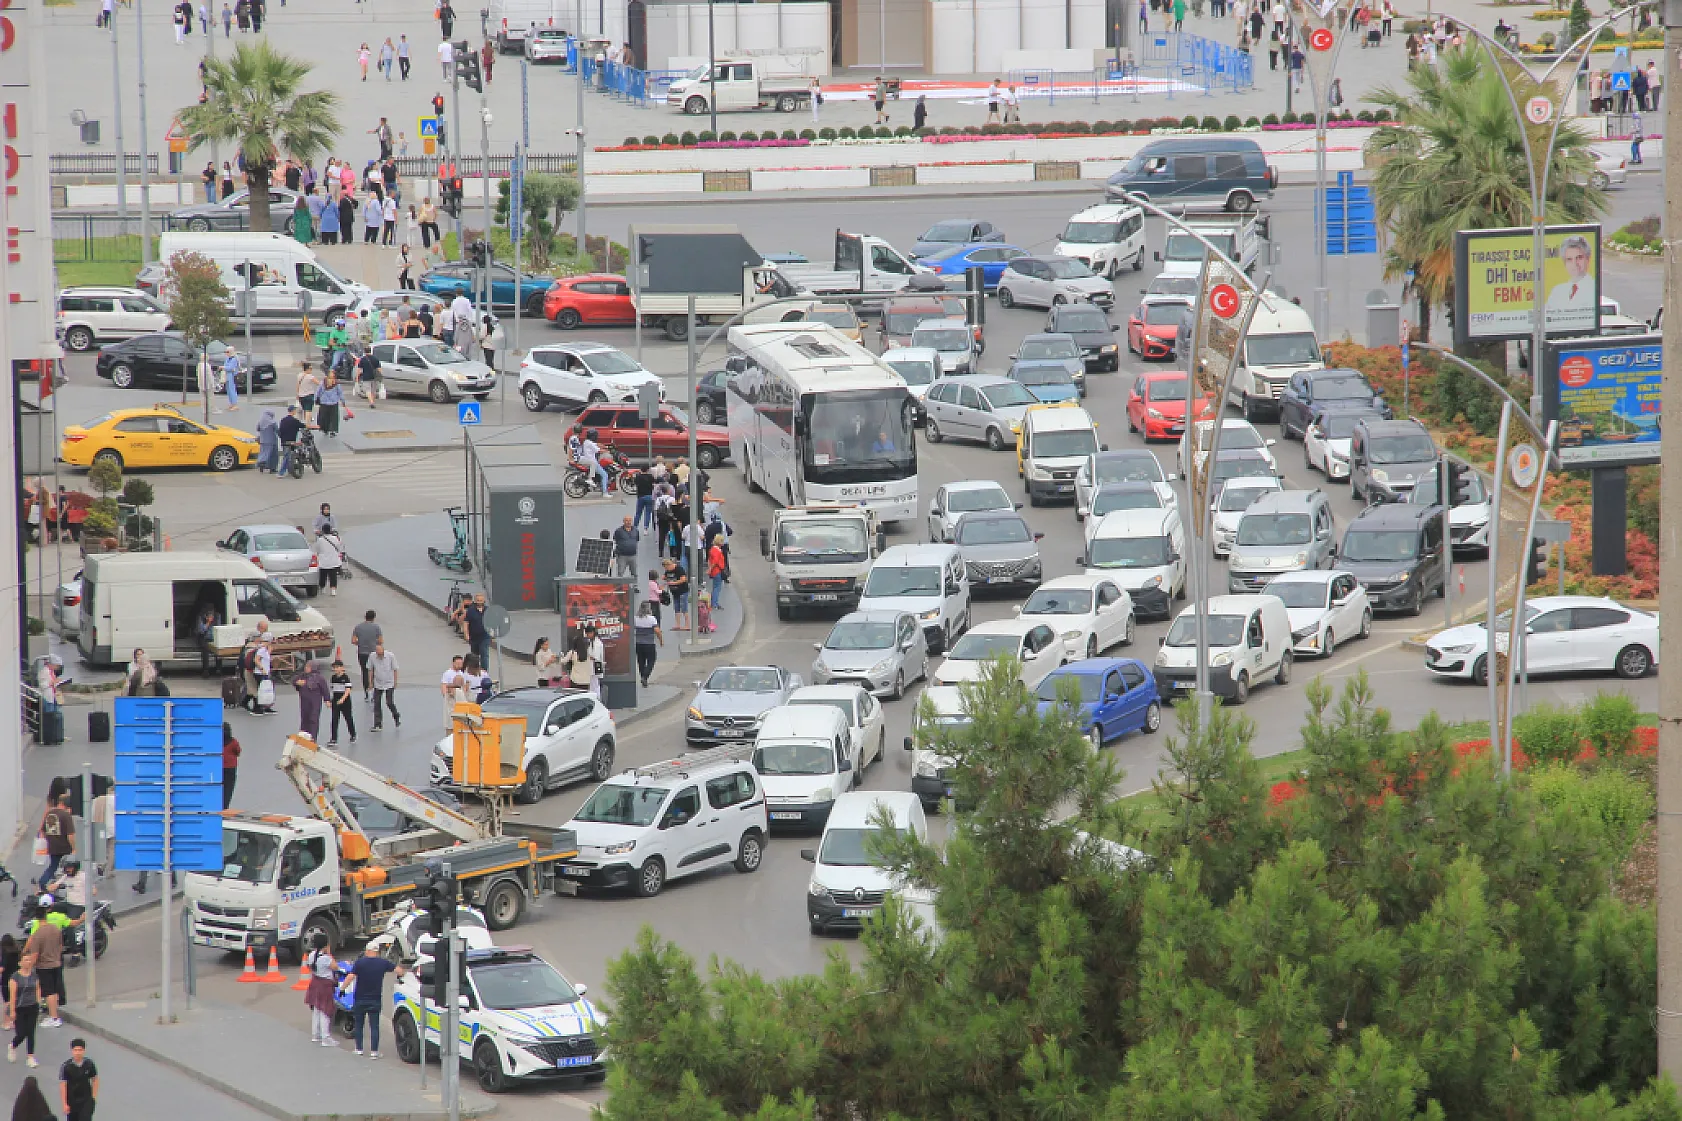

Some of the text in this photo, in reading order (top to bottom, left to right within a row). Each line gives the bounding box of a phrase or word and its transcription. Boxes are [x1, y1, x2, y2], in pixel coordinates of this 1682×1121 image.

[1513, 249, 1531, 263] SAÇ
[1486, 263, 1508, 285] DHİ
[520, 532, 537, 602] SAMSUN
